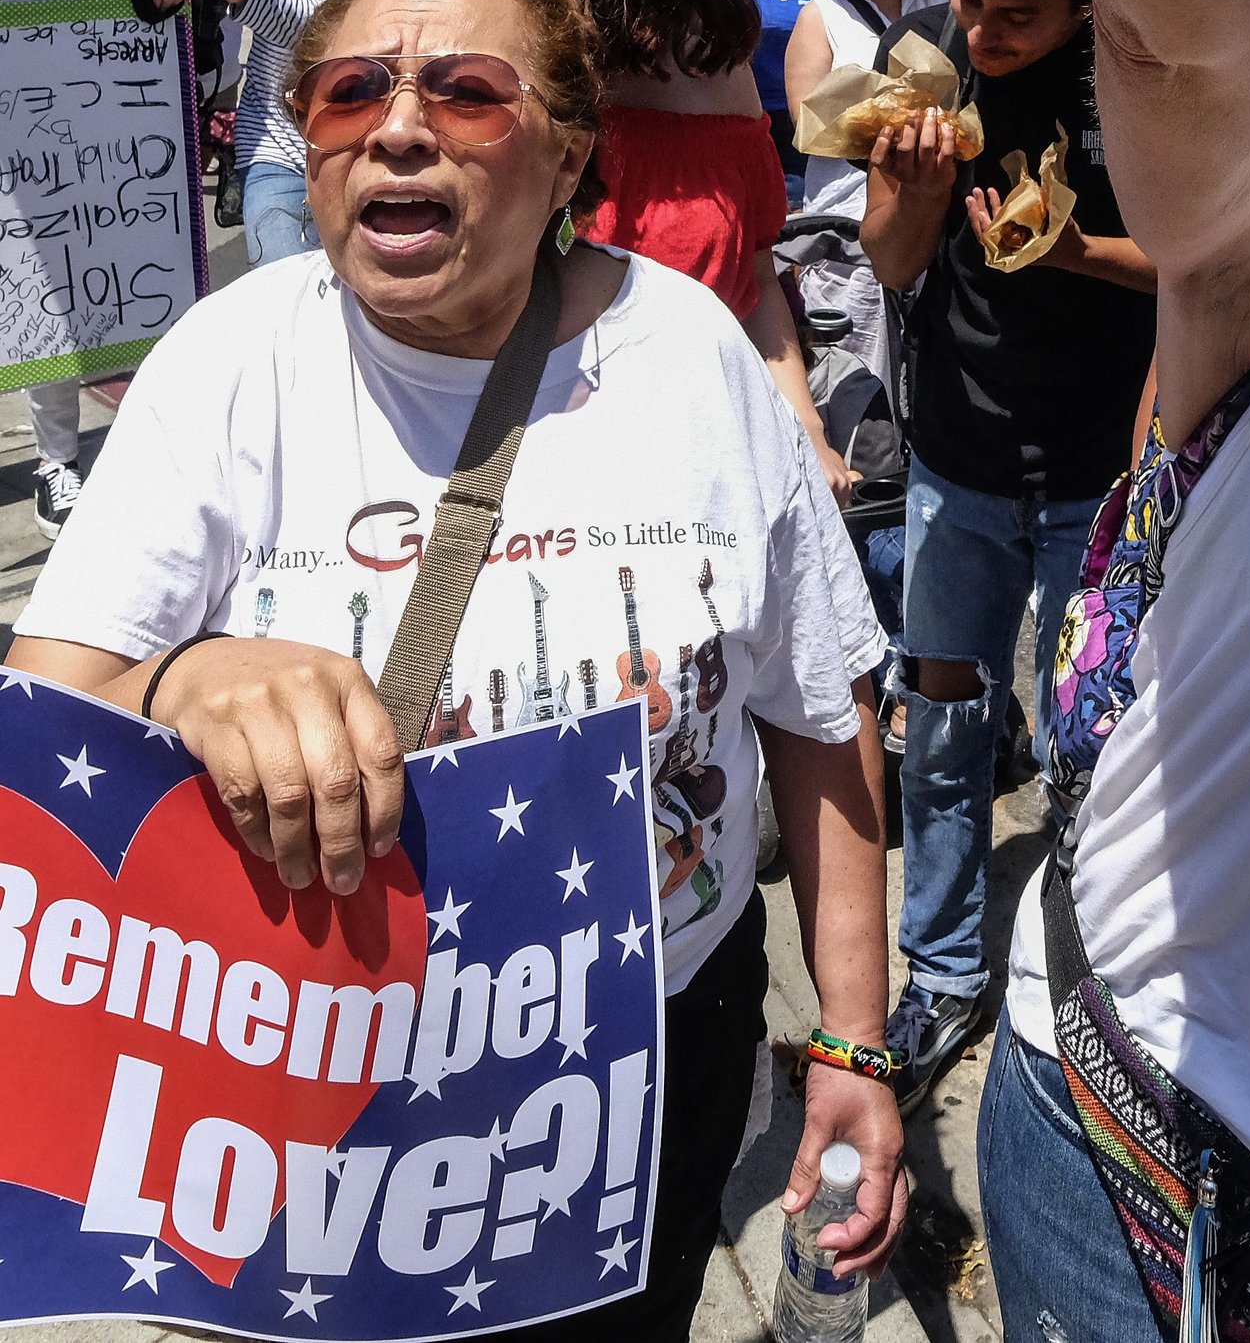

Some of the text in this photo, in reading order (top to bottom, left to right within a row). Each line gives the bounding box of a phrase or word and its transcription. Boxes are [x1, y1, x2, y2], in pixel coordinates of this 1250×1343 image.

[23, 27, 58, 45] be
[28, 114, 78, 145] By
[75, 135, 177, 184] Child
[40, 244, 175, 328] Stop
[255, 544, 344, 574] Many...
[588, 525, 616, 547] So
[623, 521, 687, 546] Little
[692, 522, 737, 549] Time
[79, 1049, 649, 1276] Love?!
